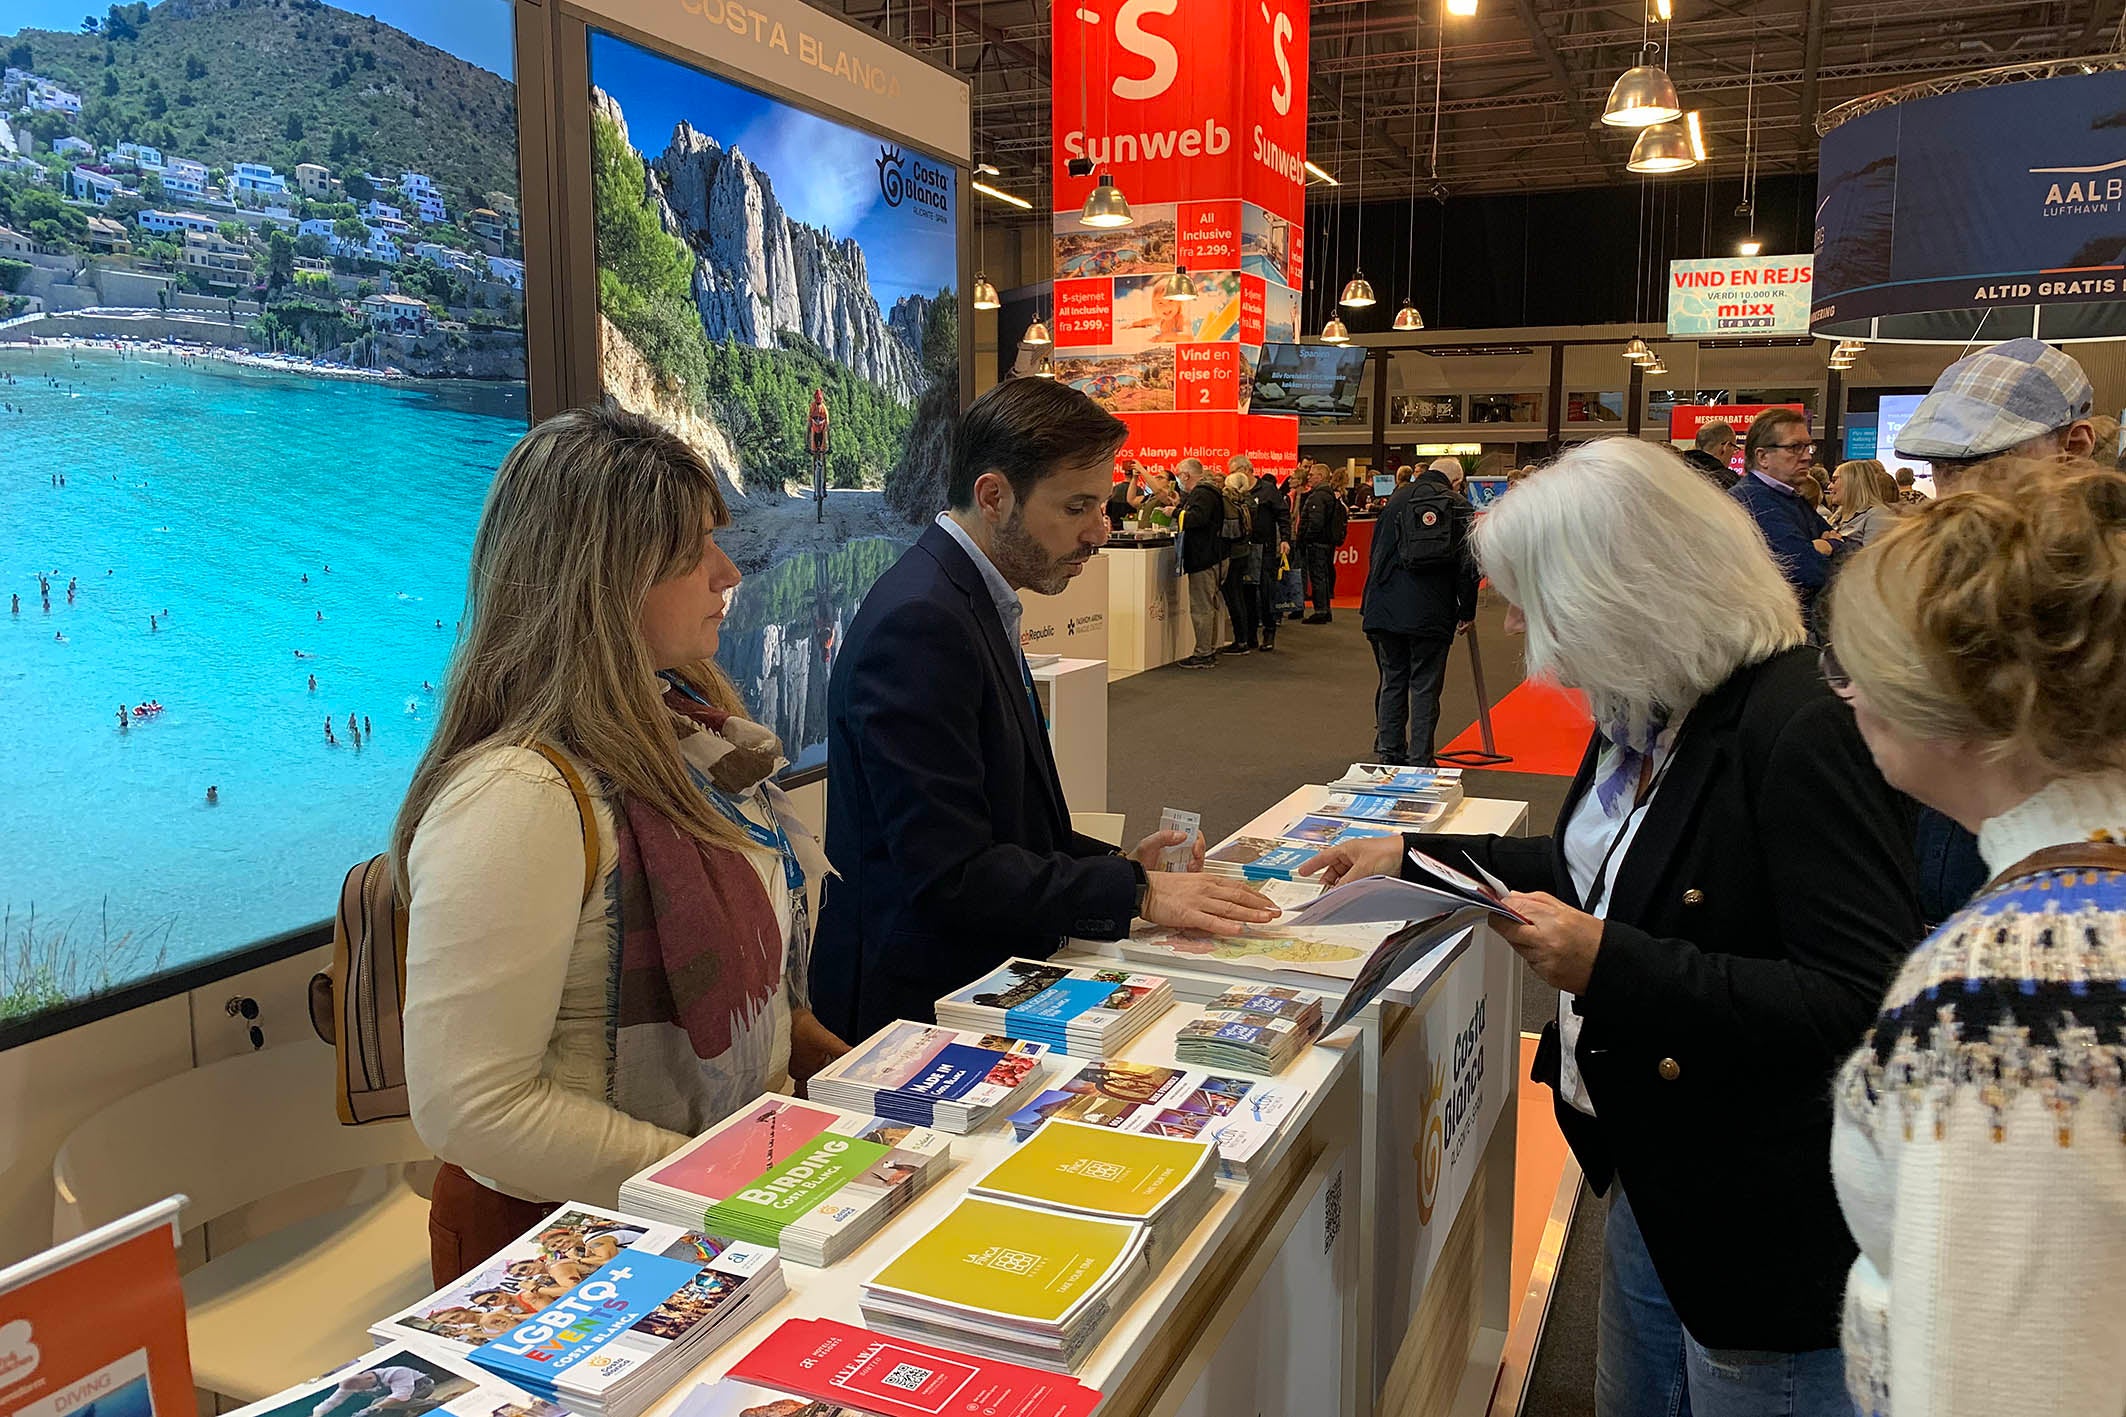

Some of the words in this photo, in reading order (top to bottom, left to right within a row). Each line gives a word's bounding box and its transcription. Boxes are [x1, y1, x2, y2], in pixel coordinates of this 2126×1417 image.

[799, 31, 899, 98] BLANCA
[1064, 118, 1231, 166] Sunweb
[1253, 125, 1304, 185] Sunweb
[914, 161, 947, 191] Costa
[906, 178, 947, 211] Blanca
[1200, 212, 1214, 224] All
[2043, 203, 2108, 217] LUFTHAVN
[1183, 230, 1232, 241] Inclusive
[1180, 246, 1195, 257] fra
[1197, 245, 1235, 259] 2.299,-
[1674, 271, 1725, 288] VIND
[1731, 270, 1757, 286] EN
[1062, 293, 1105, 305] 5-stjernet
[1707, 293, 1737, 301] VÆRDI
[1741, 290, 1770, 299] 10.000
[1773, 289, 1788, 297] KR.
[1974, 284, 2031, 300] ALTID
[2038, 279, 2116, 296] GRATIS
[1059, 308, 1069, 317] All
[1072, 306, 1110, 318] Inclusive
[1718, 299, 1775, 317] mixx
[1059, 320, 1073, 332] fra
[1074, 318, 1109, 333] 2.999,-
[1181, 349, 1210, 361] Vind
[1214, 351, 1230, 361] en
[1180, 368, 1210, 383] rejse
[1213, 368, 1233, 379] for
[1199, 389, 1211, 403] 2
[1140, 447, 1177, 459] Alanya
[1183, 446, 1231, 458] Mallorca
[1454, 998, 1486, 1083] Costa
[908, 1072, 946, 1094] MADE
[1445, 1044, 1484, 1150] Blanca
[735, 1140, 849, 1206] BIRDING
[772, 1190, 809, 1209] COSTA
[801, 1165, 843, 1190] BLANCA
[973, 1247, 1001, 1266] FINCA
[491, 1266, 634, 1356] LGBTQ+
[524, 1298, 629, 1362] EVENTS
[552, 1345, 595, 1368] COSTA
[592, 1311, 640, 1344] BLANCA
[54, 1372, 111, 1413] DIVING
